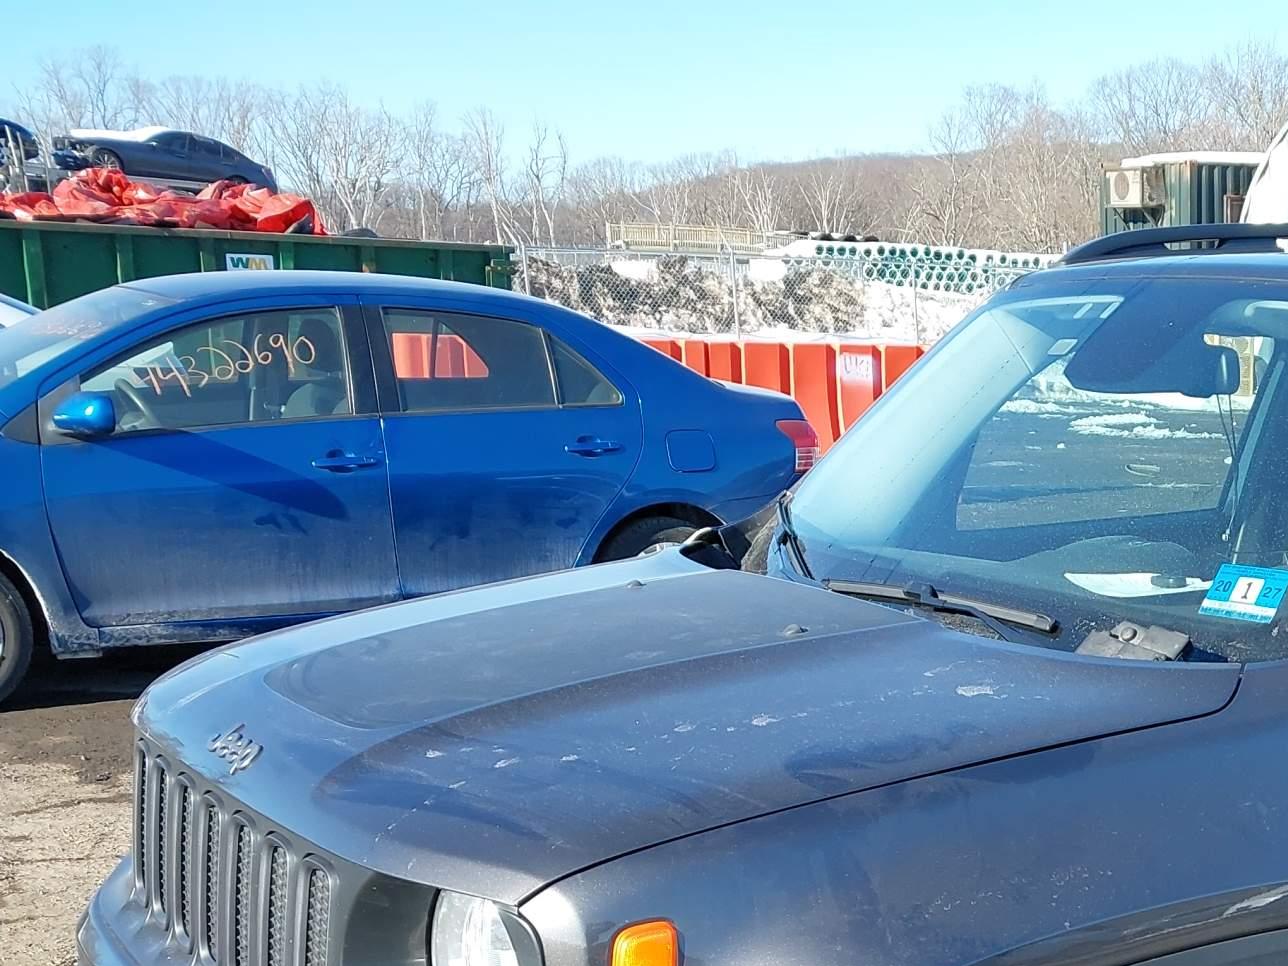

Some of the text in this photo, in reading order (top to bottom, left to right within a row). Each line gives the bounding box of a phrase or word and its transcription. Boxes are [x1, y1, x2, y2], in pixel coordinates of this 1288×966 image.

[1214, 580, 1282, 600] 20 1 27
[207, 723, 263, 776] Jeep
